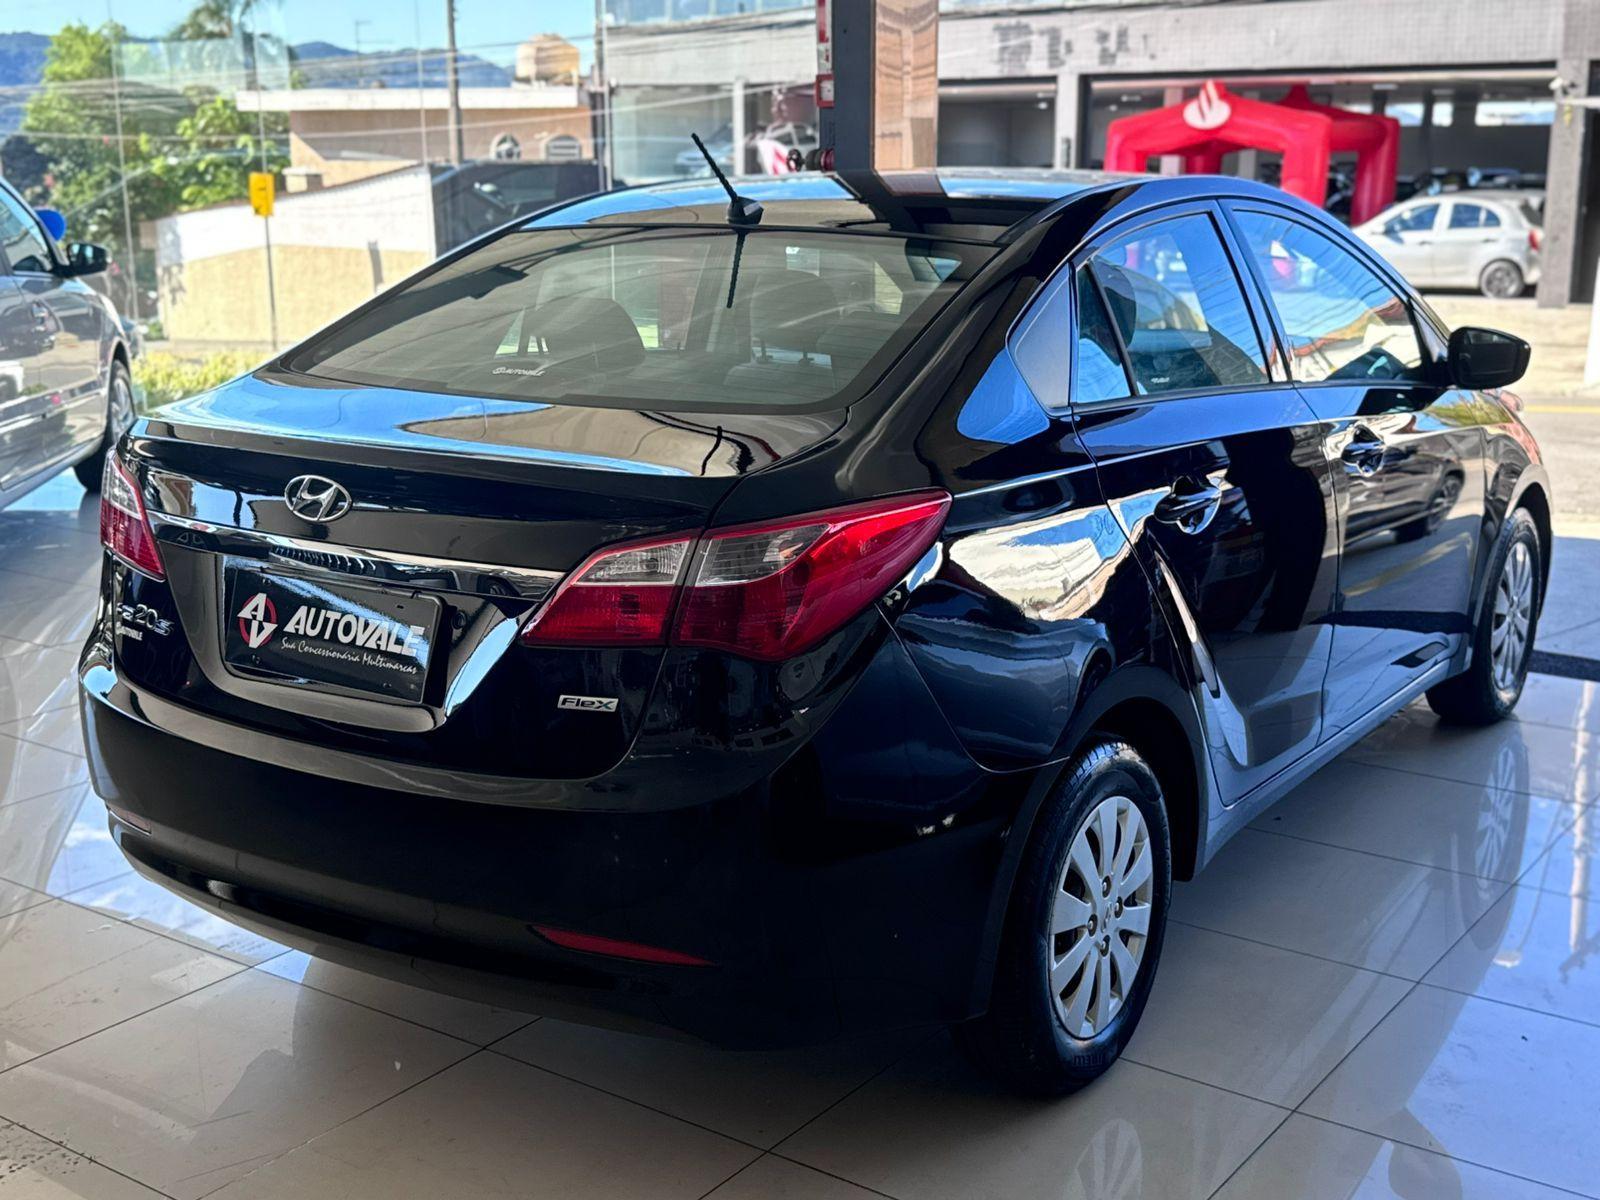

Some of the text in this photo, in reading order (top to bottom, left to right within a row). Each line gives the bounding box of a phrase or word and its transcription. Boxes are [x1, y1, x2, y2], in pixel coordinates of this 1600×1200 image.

[283, 605, 425, 657] AUTOVALE
[281, 637, 296, 650] Sua
[362, 652, 418, 675] Multimarcas
[561, 697, 616, 710] Flex
